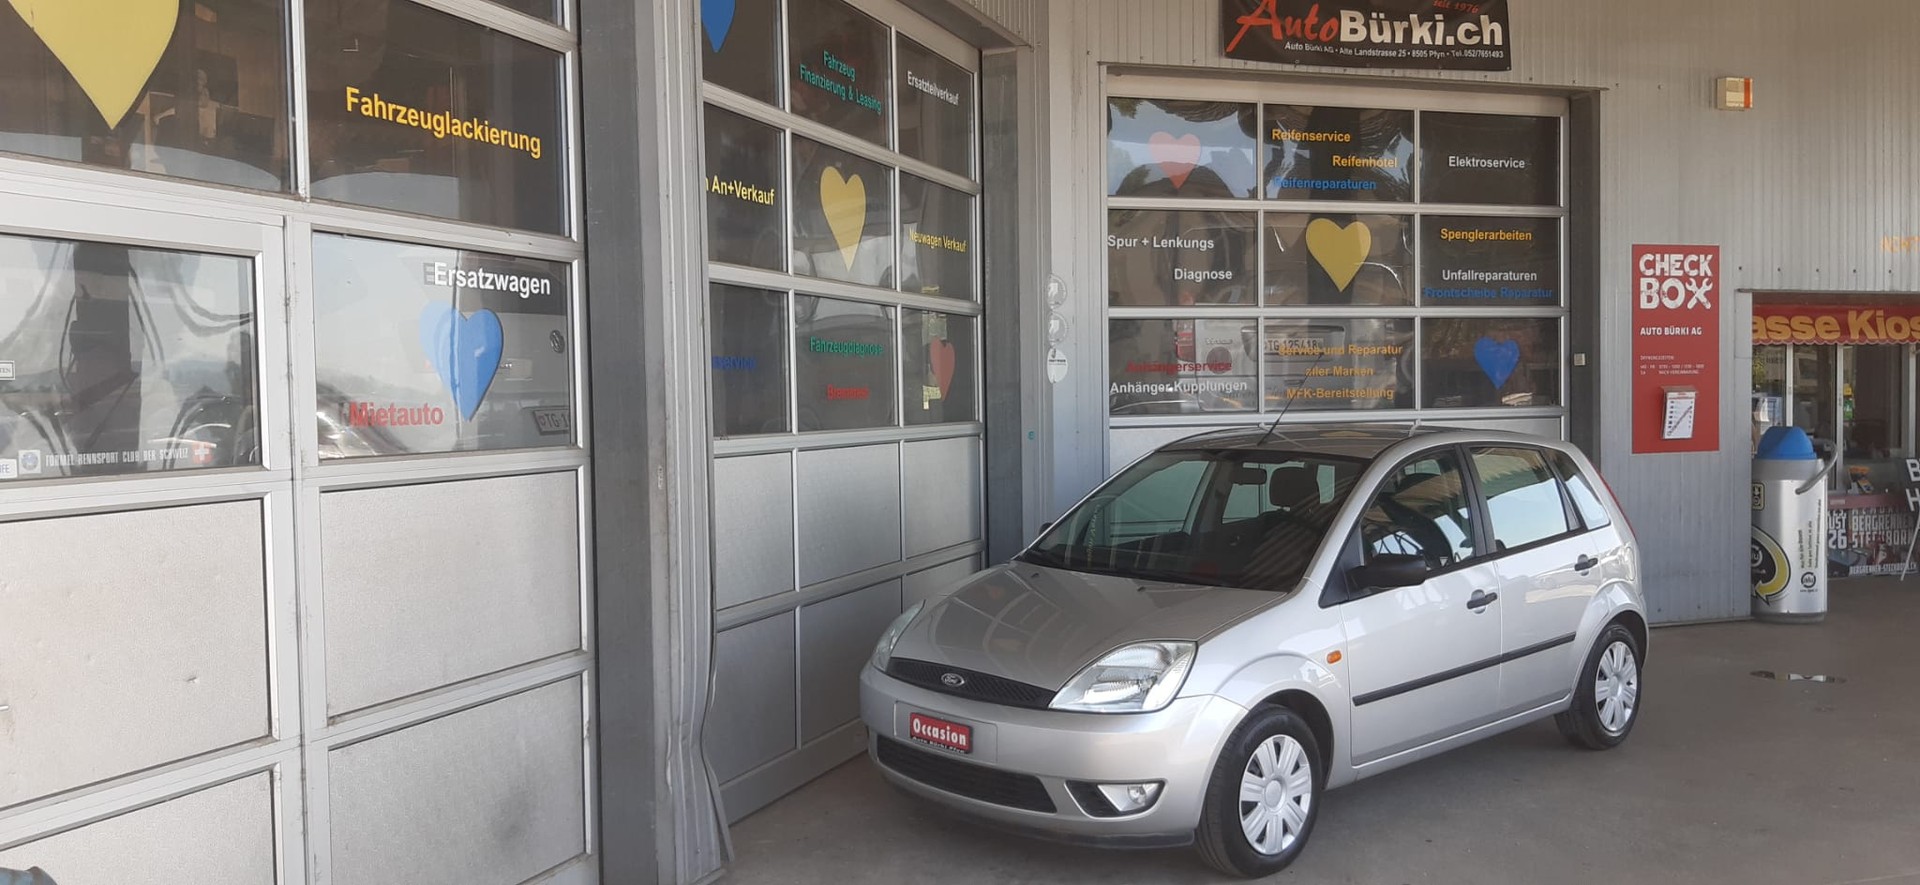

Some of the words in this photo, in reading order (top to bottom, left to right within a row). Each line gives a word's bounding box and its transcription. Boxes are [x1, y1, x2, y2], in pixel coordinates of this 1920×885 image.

[1284, 41, 1304, 51] Auto
[1305, 43, 1323, 52] Bürki
[1324, 46, 1335, 54] AG
[1354, 48, 1397, 57] Landstrasse
[1411, 50, 1428, 58] 8505
[823, 51, 856, 82] Fahrzeug
[800, 64, 847, 100] Finanzierung
[856, 91, 882, 116] Leasing
[907, 71, 959, 106] Ersatzteilverkauf
[345, 86, 542, 160] Fahrzeuglackierung
[1272, 128, 1351, 143] Reifenservice
[1332, 156, 1398, 168] Reifenhotel
[1448, 156, 1526, 169] Elektroservice
[711, 175, 775, 206] An+Verkauf
[1272, 176, 1377, 190] Reifenreparaturen
[909, 228, 942, 248] Neuwagen
[943, 234, 968, 253] Verkauf
[1107, 235, 1138, 249] Spur
[1141, 239, 1150, 247] +
[1153, 236, 1214, 251] Lenkungs
[1440, 228, 1532, 242] Spenglerarbeiten
[1639, 254, 1713, 277] CHECK
[434, 261, 551, 298] Ersatzwagen
[1174, 268, 1233, 282] Diagnose
[1442, 270, 1537, 283] Unfallreparaturen
[1424, 288, 1497, 299] Frontscheibe
[1500, 288, 1553, 300] Reparatur
[1640, 327, 1662, 335] AUTO
[1664, 326, 1689, 335] BÜRKI
[810, 337, 884, 357] Fahrzeugdiagnose
[1323, 346, 1345, 355] und
[1348, 344, 1403, 355] Reparatur
[1333, 366, 1374, 377] Marken
[1174, 380, 1248, 394] Kupplungen
[1286, 388, 1394, 400] MFK-Bereitstellung
[350, 401, 444, 427] Mietauto
[77, 451, 119, 465] RENNSPORT
[123, 450, 139, 463] CLUB
[143, 450, 156, 462] DER
[159, 447, 189, 460] SCHWEIZ
[1828, 529, 1847, 549] 26
[913, 718, 966, 746] Occasion
